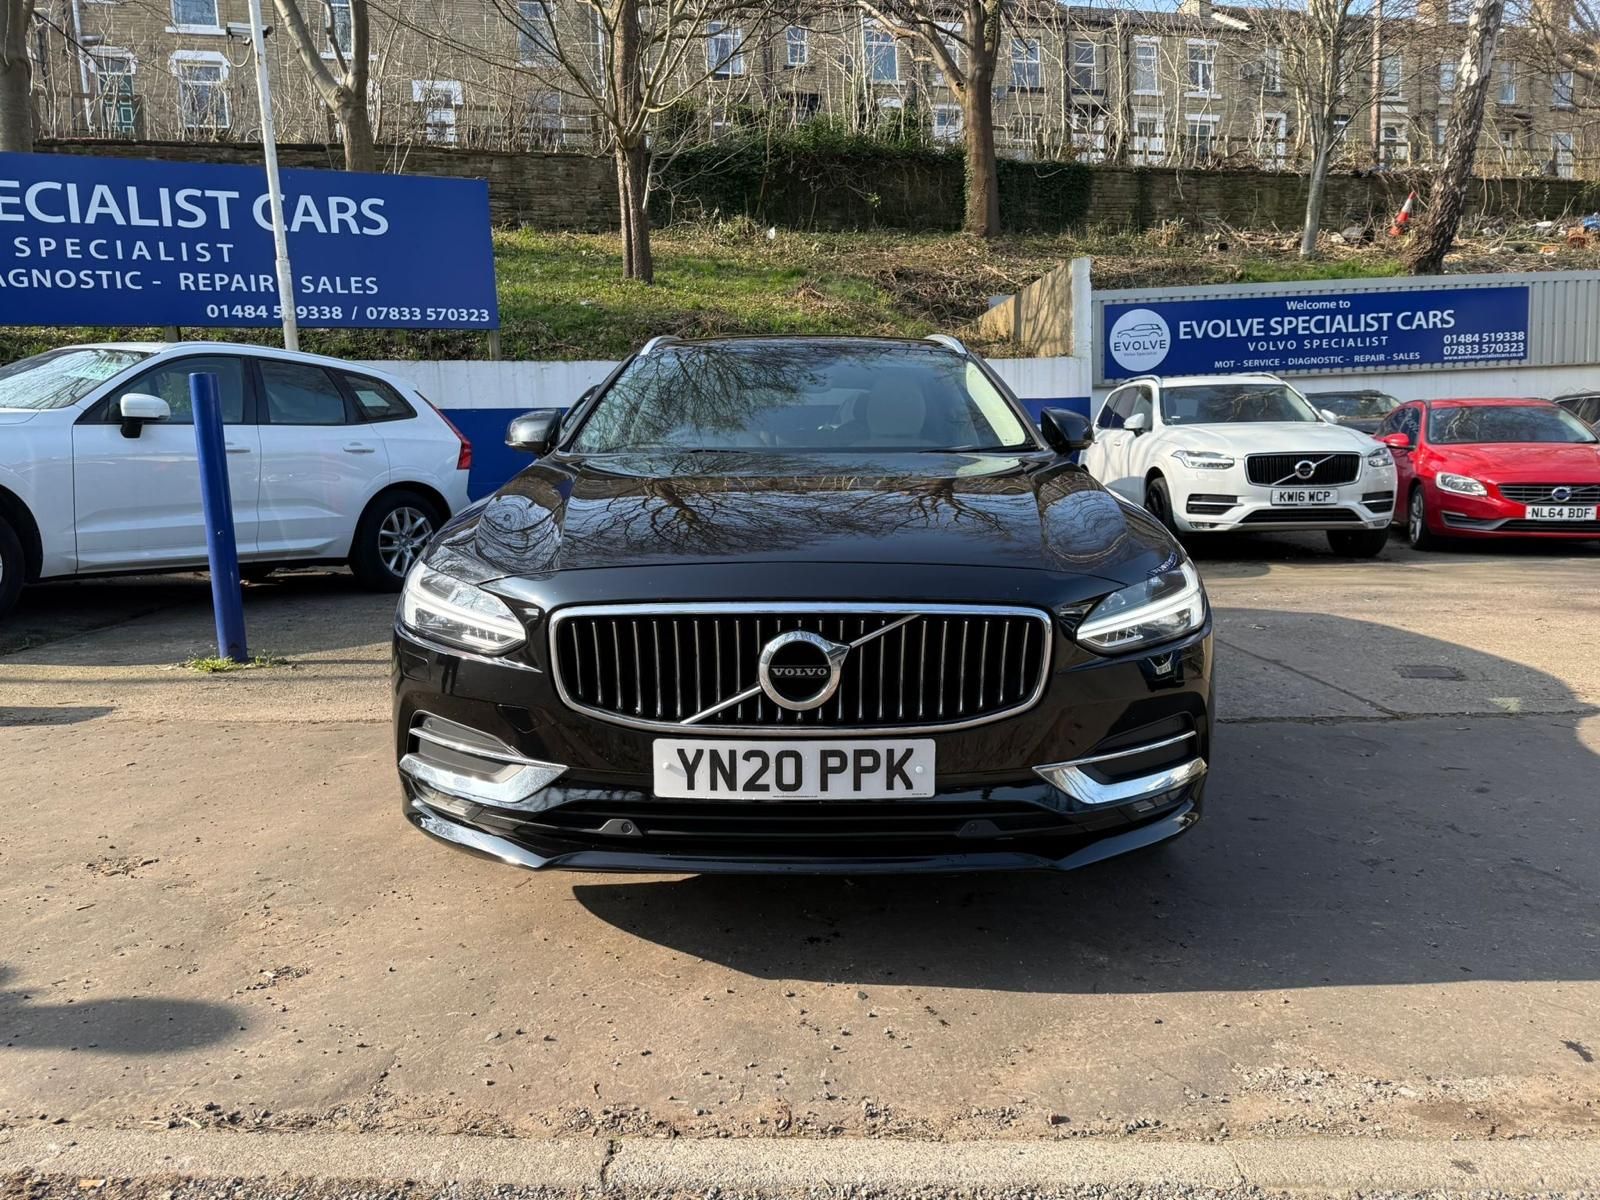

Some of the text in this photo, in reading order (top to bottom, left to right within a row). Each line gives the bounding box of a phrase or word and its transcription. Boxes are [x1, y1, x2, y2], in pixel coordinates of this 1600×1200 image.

[0, 180, 389, 235] ECIALIST CARS
[13, 237, 234, 262] SPECIALIST
[179, 272, 275, 293] REPAIR
[301, 275, 379, 294] SALES
[206, 304, 268, 318] 01484
[273, 305, 343, 319] 59338
[366, 306, 421, 320] 07833
[426, 308, 490, 321] 570323
[1286, 300, 1351, 310] Welcome to
[1179, 309, 1456, 340] EVOLVE SPECIALIST CARS
[1113, 339, 1167, 351] EVOLVE
[1247, 336, 1389, 351] VOLVO SPECIALIST
[1443, 331, 1525, 344] 01484 519338
[1443, 342, 1524, 355] 07833 570323
[1214, 360, 1235, 368] MOT
[1243, 358, 1280, 367] SERVICE
[1288, 355, 1344, 365] DIAGNOSTIC
[1354, 353, 1385, 362] REPAIR
[1393, 352, 1420, 361] SALES
[1280, 491, 1330, 502] KW16 WCP
[1531, 508, 1592, 518] NL64 BDF
[771, 667, 828, 676] VOLVO
[677, 748, 914, 792] YN20 PPK
